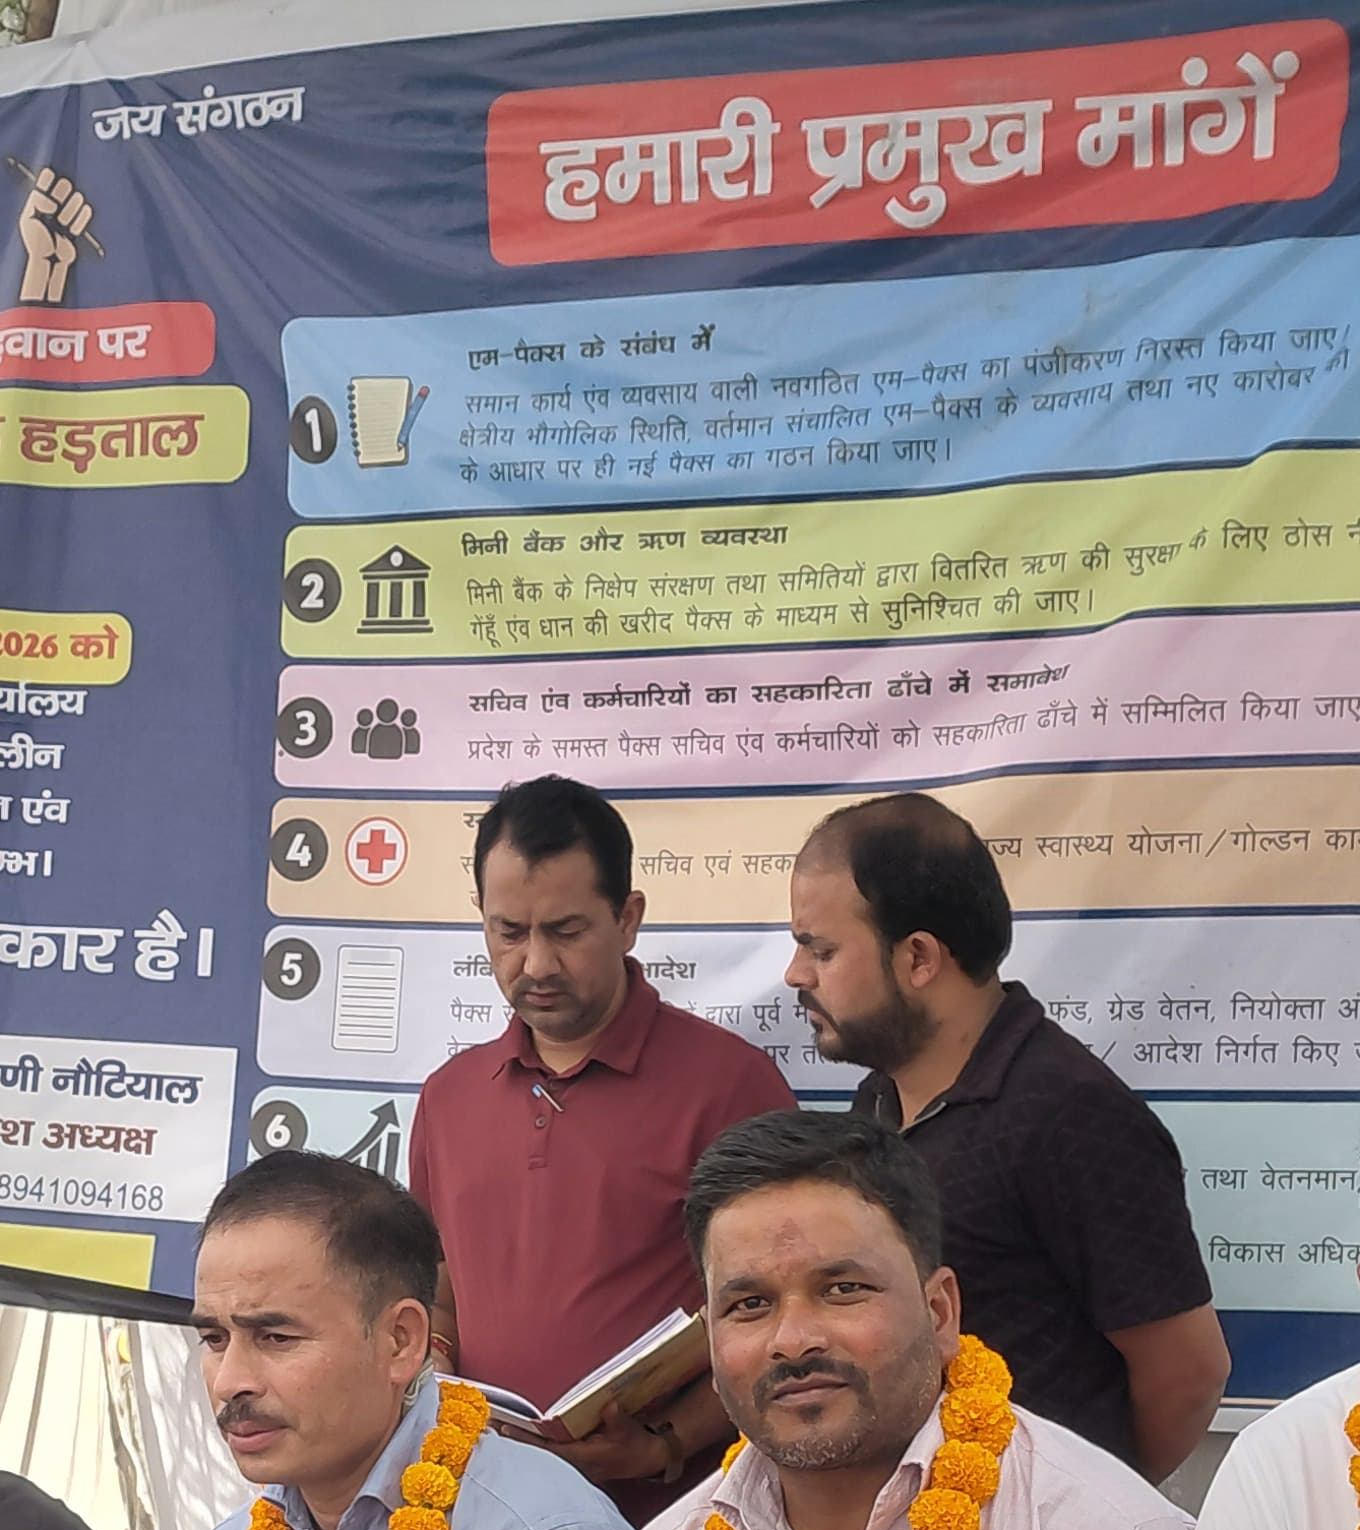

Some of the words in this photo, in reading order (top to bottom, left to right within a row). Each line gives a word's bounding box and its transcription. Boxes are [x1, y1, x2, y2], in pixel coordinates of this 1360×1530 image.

[92, 103, 166, 140] जय
[173, 85, 305, 137] संगठन
[539, 96, 781, 222] हमारी
[801, 98, 1052, 229] प्रमुख
[1074, 50, 1300, 169] मांगें
[97, 324, 151, 359] पर
[580, 335, 605, 359] के
[692, 324, 716, 351] में
[304, 408, 322, 452] 1
[460, 457, 479, 483] के
[489, 456, 544, 482] आधार
[558, 459, 580, 478] पर
[594, 455, 615, 478] ही
[628, 453, 657, 478] नई
[669, 449, 714, 475] पैक्स
[727, 452, 752, 472] का
[766, 446, 814, 468] गठन
[827, 438, 879, 464] किया
[461, 530, 508, 557] मिनी
[523, 527, 565, 552] बैंक
[580, 527, 624, 552] और
[701, 526, 788, 547] व्यवस्था
[300, 573, 325, 609] 2
[540, 617, 573, 639] धान
[584, 609, 608, 636] की
[619, 606, 673, 634] खरीद
[686, 605, 732, 631] पैक्स
[744, 603, 765, 628] के
[776, 604, 838, 627] माध्यम
[849, 596, 869, 624] से
[882, 592, 982, 630] सुनिश्चित
[994, 587, 1021, 614] की
[70, 624, 118, 660] को
[469, 688, 527, 712] सचिव
[583, 681, 691, 708] कर्मचारियों
[705, 686, 737, 704] का
[752, 675, 872, 702] सहकारिता
[948, 670, 971, 695] में
[294, 710, 317, 746] 3
[286, 833, 312, 868] 4
[1036, 834, 1113, 858] स्वास्थ्य
[280, 952, 303, 986] 5
[1231, 992, 1326, 1022] नियोक्ता
[1134, 1037, 1202, 1065] आदेश
[1216, 1036, 1278, 1065] निर्गत
[1293, 1037, 1339, 1066] किए
[51, 1057, 203, 1104] नौटियाल
[42, 1124, 158, 1155] अध्यक्ष
[265, 1114, 291, 1148] 6
[1201, 1169, 1248, 1191] तथा
[1209, 1237, 1284, 1263] विकास
